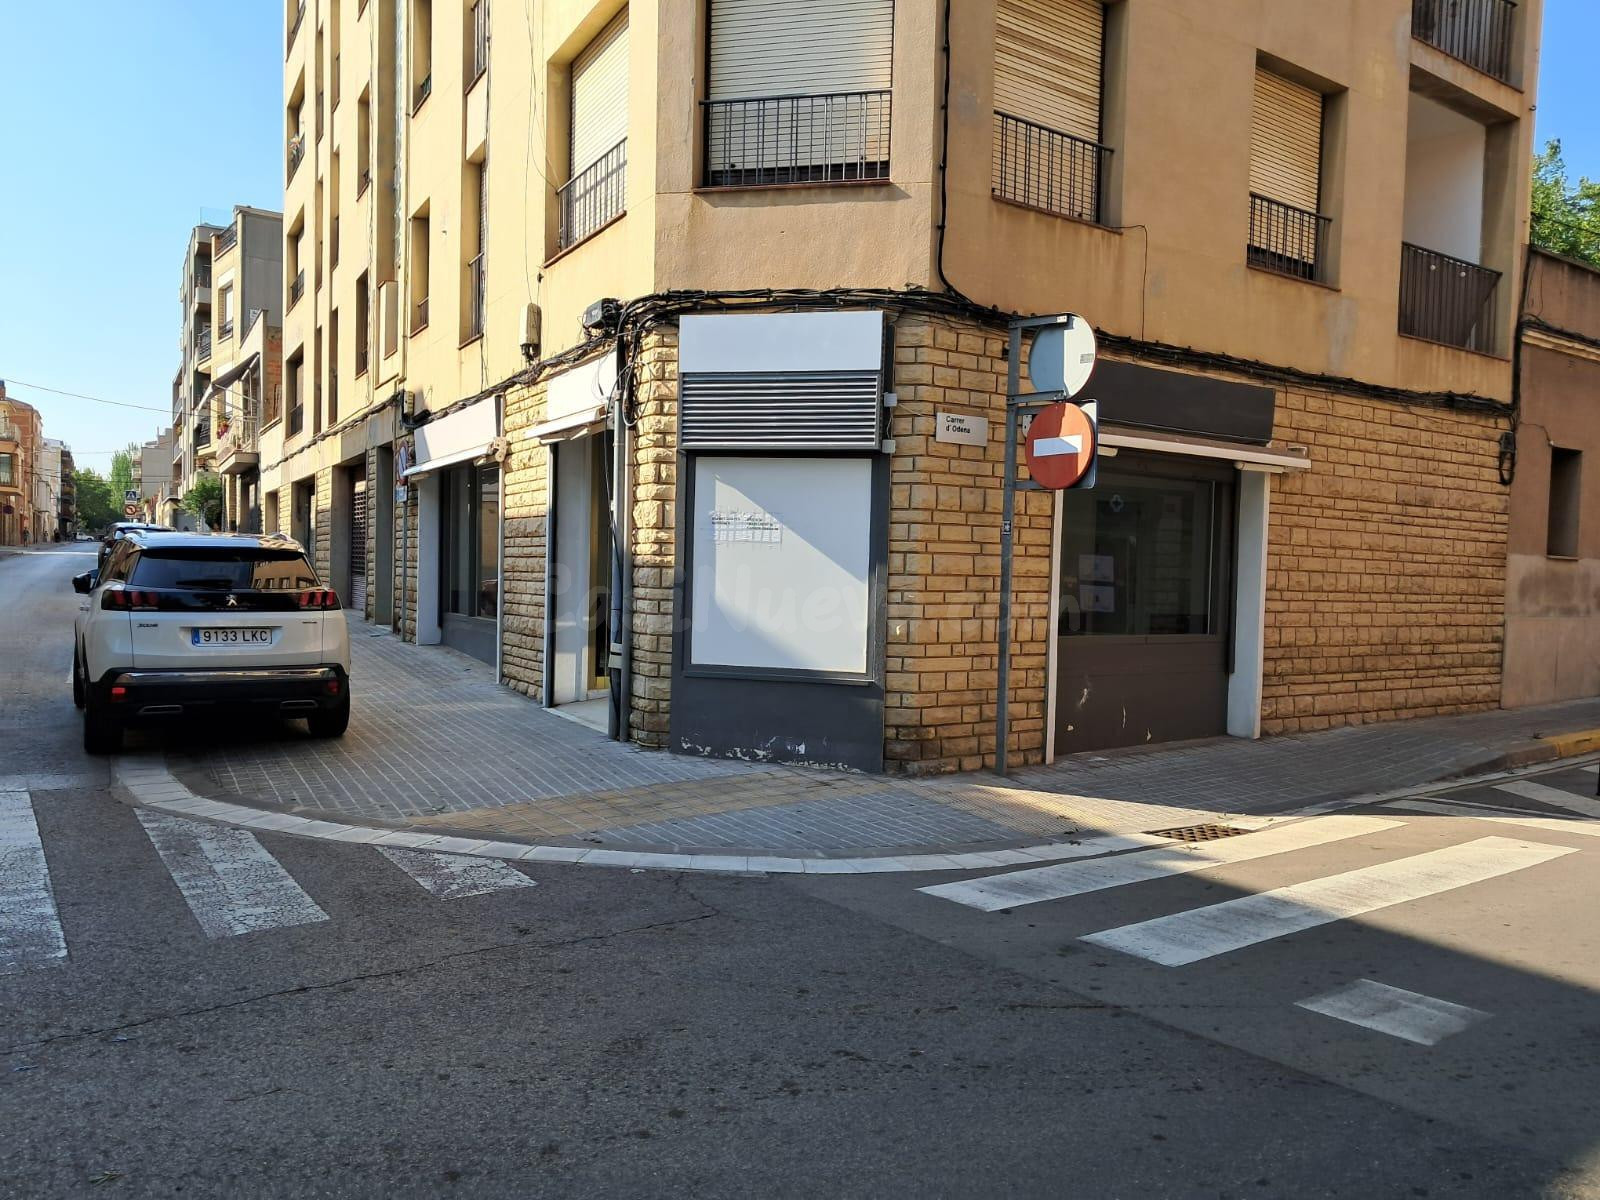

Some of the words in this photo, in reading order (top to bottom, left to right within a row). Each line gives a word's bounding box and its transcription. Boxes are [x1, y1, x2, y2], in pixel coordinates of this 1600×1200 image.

[945, 415, 965, 424] Carrer
[203, 630, 238, 642] 9133
[242, 630, 268, 642] LKC
